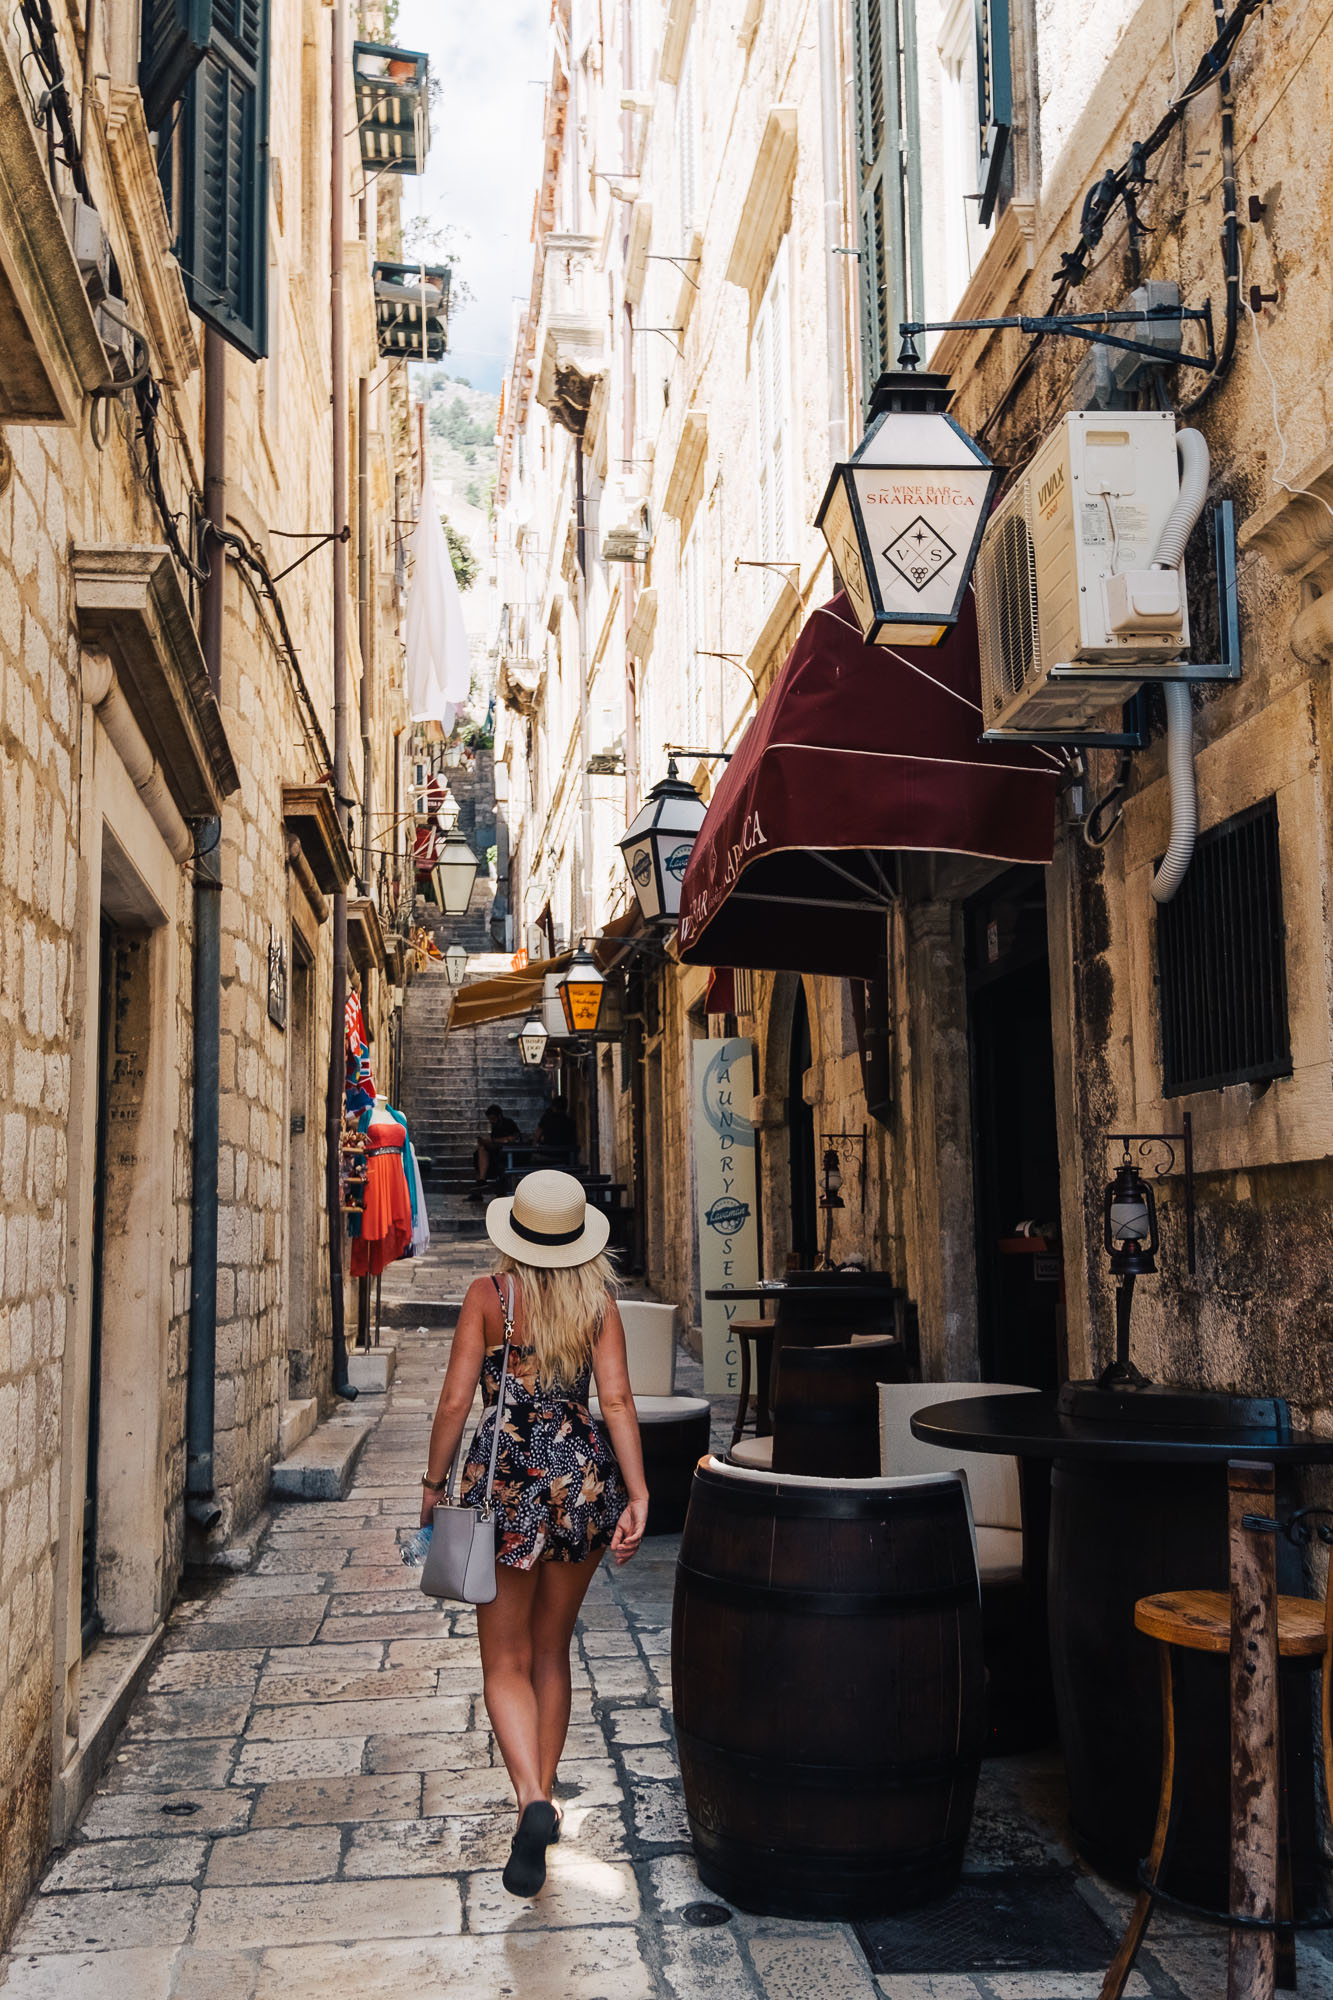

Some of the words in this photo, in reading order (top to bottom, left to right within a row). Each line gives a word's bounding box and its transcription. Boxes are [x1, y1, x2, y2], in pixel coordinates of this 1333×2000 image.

[892, 485, 922, 495] WINE
[926, 486, 950, 496] BAR
[1038, 463, 1064, 507] VIVAX
[896, 549, 909, 561] V
[930, 548, 942, 561] S
[717, 1046, 735, 1194] LAUNDRY
[721, 1238, 738, 1388] SEVICE
